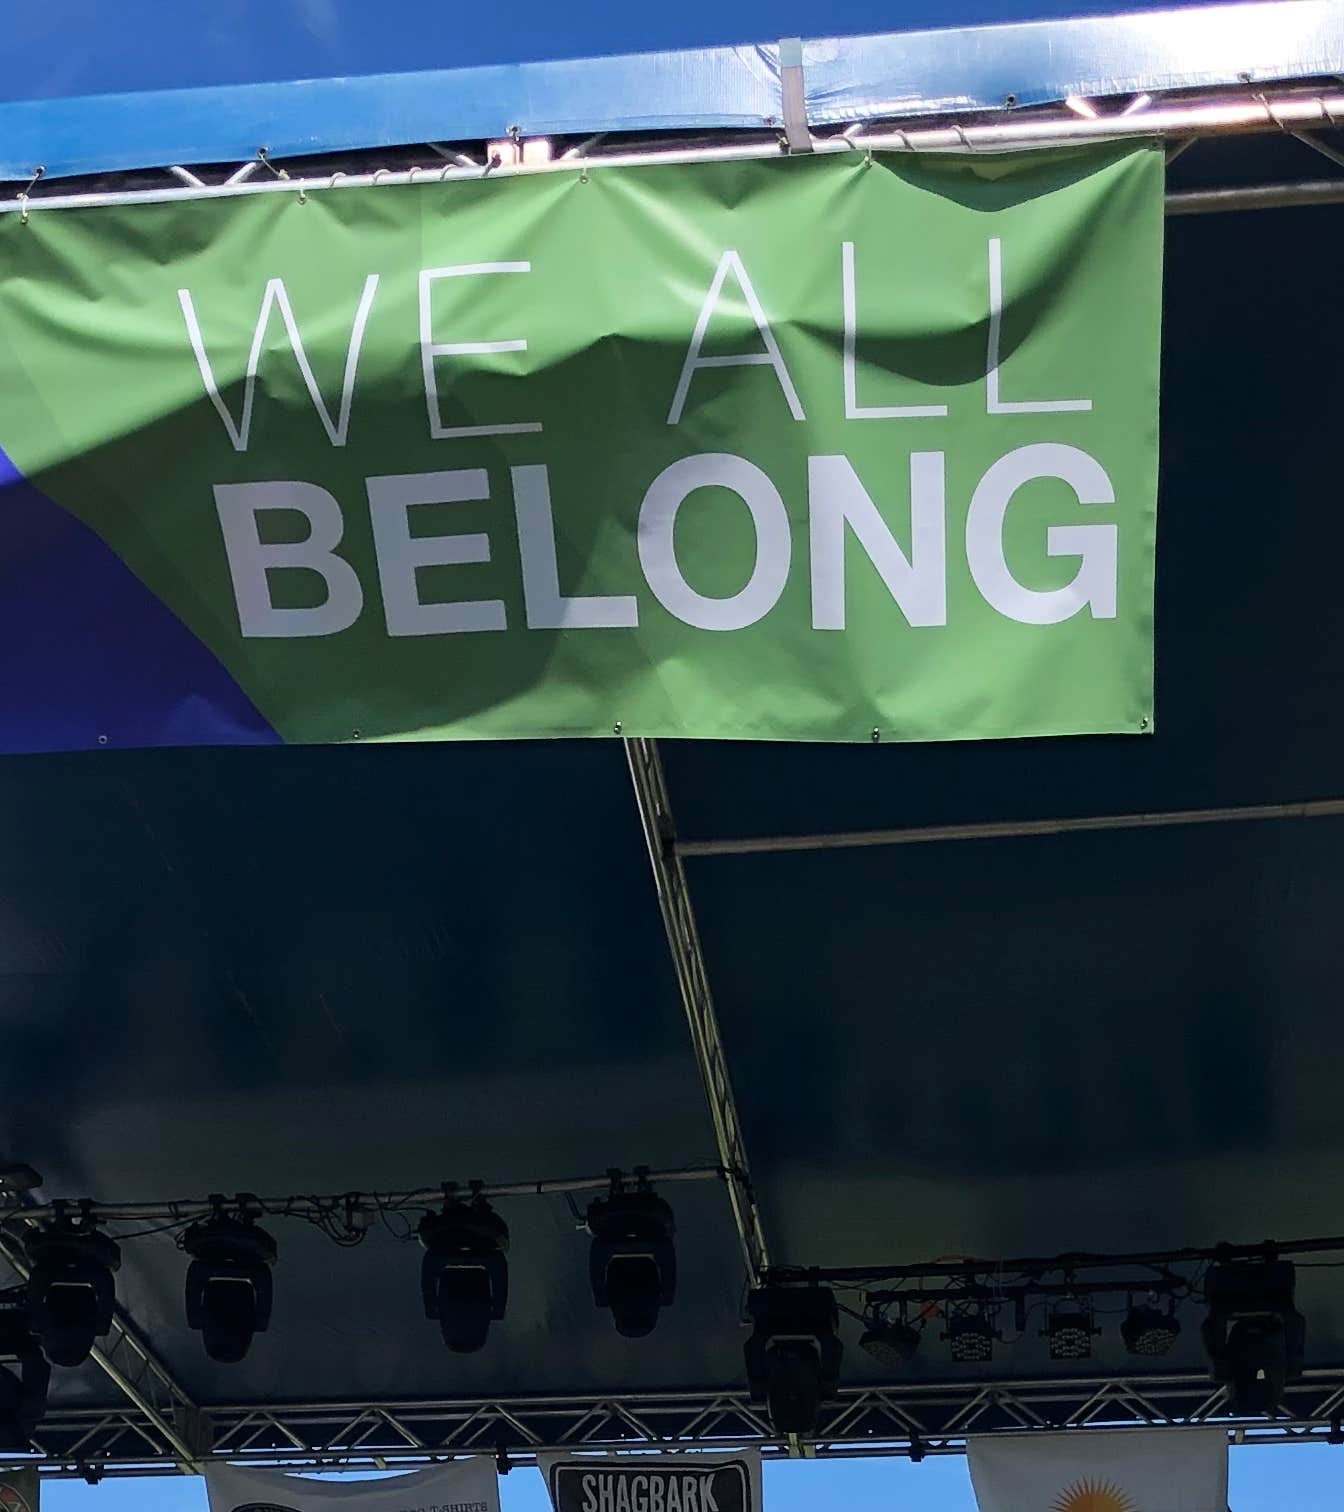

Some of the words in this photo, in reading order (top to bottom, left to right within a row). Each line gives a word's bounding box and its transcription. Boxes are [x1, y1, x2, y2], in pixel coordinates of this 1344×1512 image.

[177, 261, 543, 453] WE
[667, 236, 1092, 425] ALL
[212, 442, 1118, 639] BELONG
